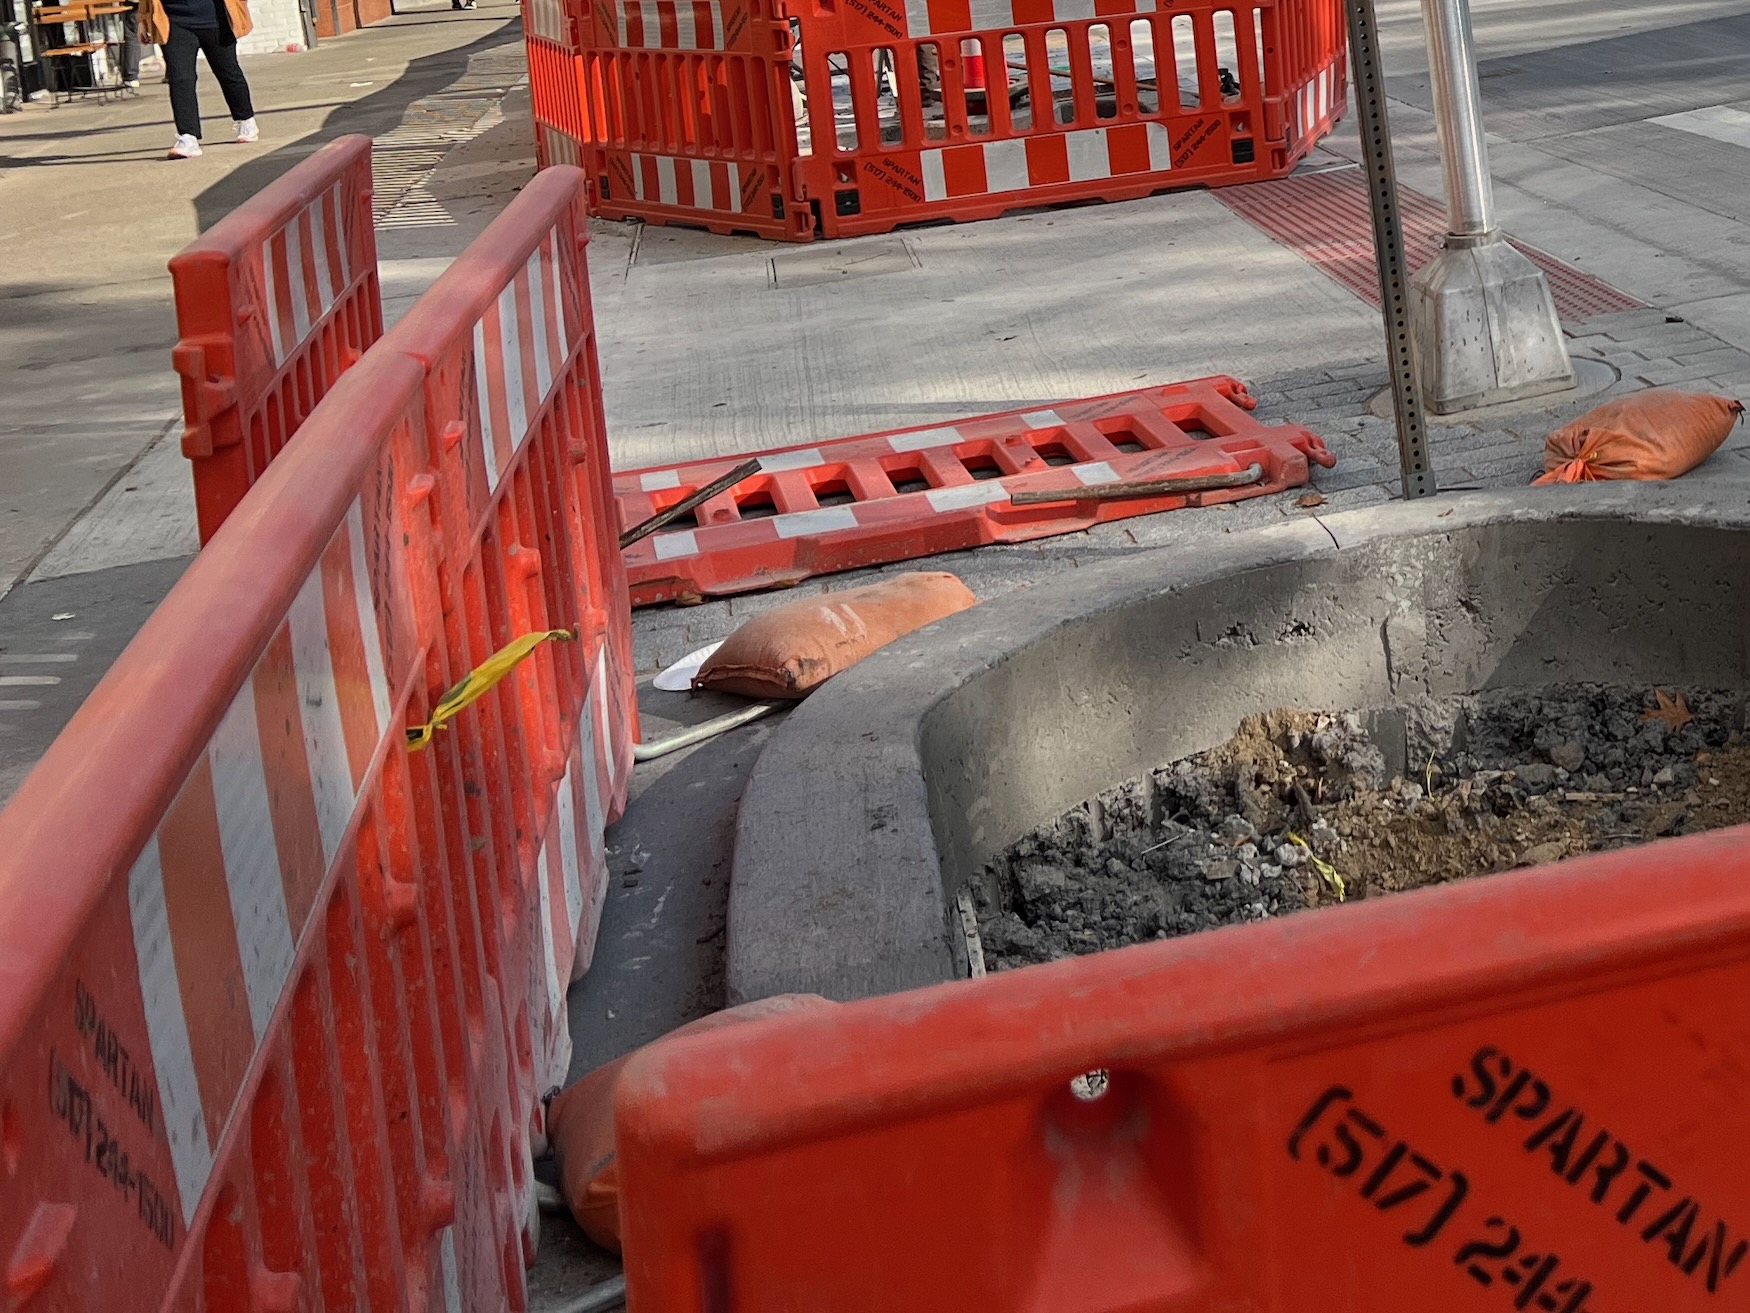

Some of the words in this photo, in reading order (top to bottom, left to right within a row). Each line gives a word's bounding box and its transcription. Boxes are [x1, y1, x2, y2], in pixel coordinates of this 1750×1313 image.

[867, 10, 903, 39] 244-1500
[1172, 118, 1205, 151] SPARTAN
[864, 161, 887, 180] (517)
[882, 157, 921, 186] SPARTAN
[1286, 1084, 1469, 1248] (517)
[1451, 1044, 1750, 1295] SPARTAN
